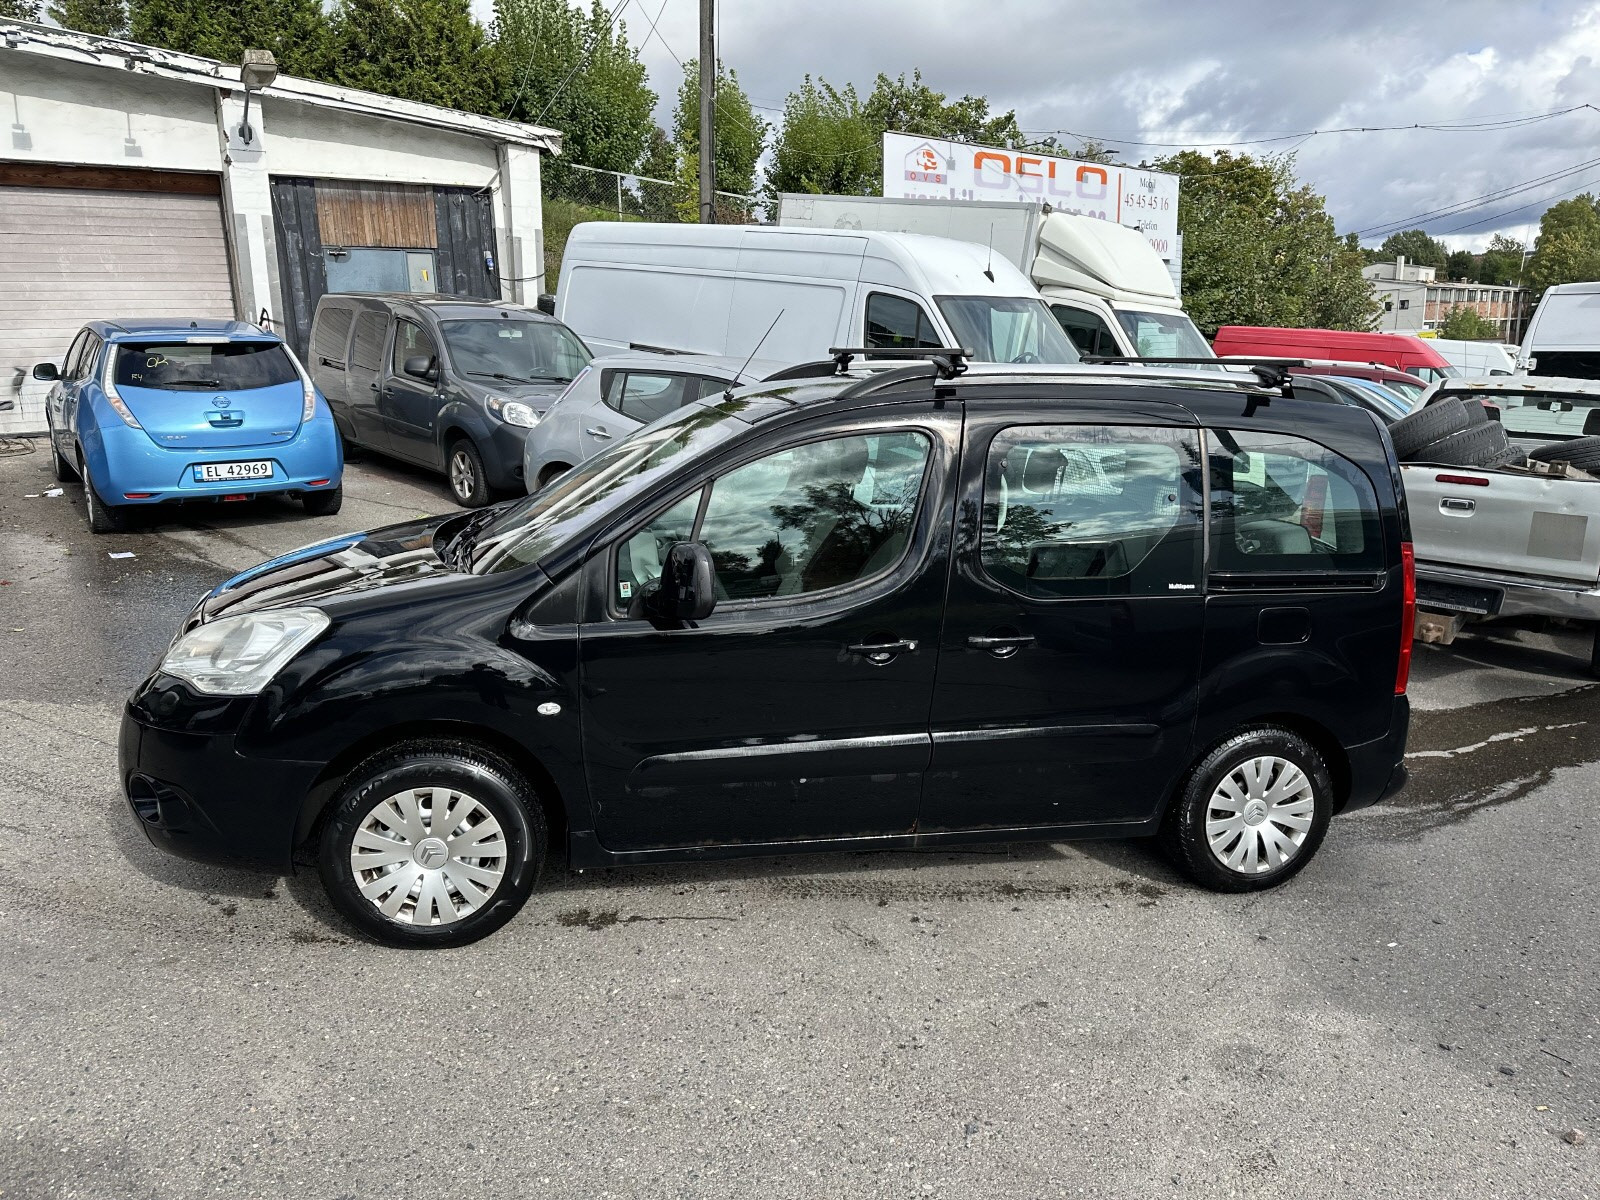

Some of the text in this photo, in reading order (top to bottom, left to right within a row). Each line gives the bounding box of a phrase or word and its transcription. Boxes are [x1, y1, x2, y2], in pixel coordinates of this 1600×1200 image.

[974, 151, 1108, 200] OSLO
[1124, 193, 1169, 211] 45 45 45 16
[206, 466, 222, 478] EL
[227, 463, 268, 477] 42969
